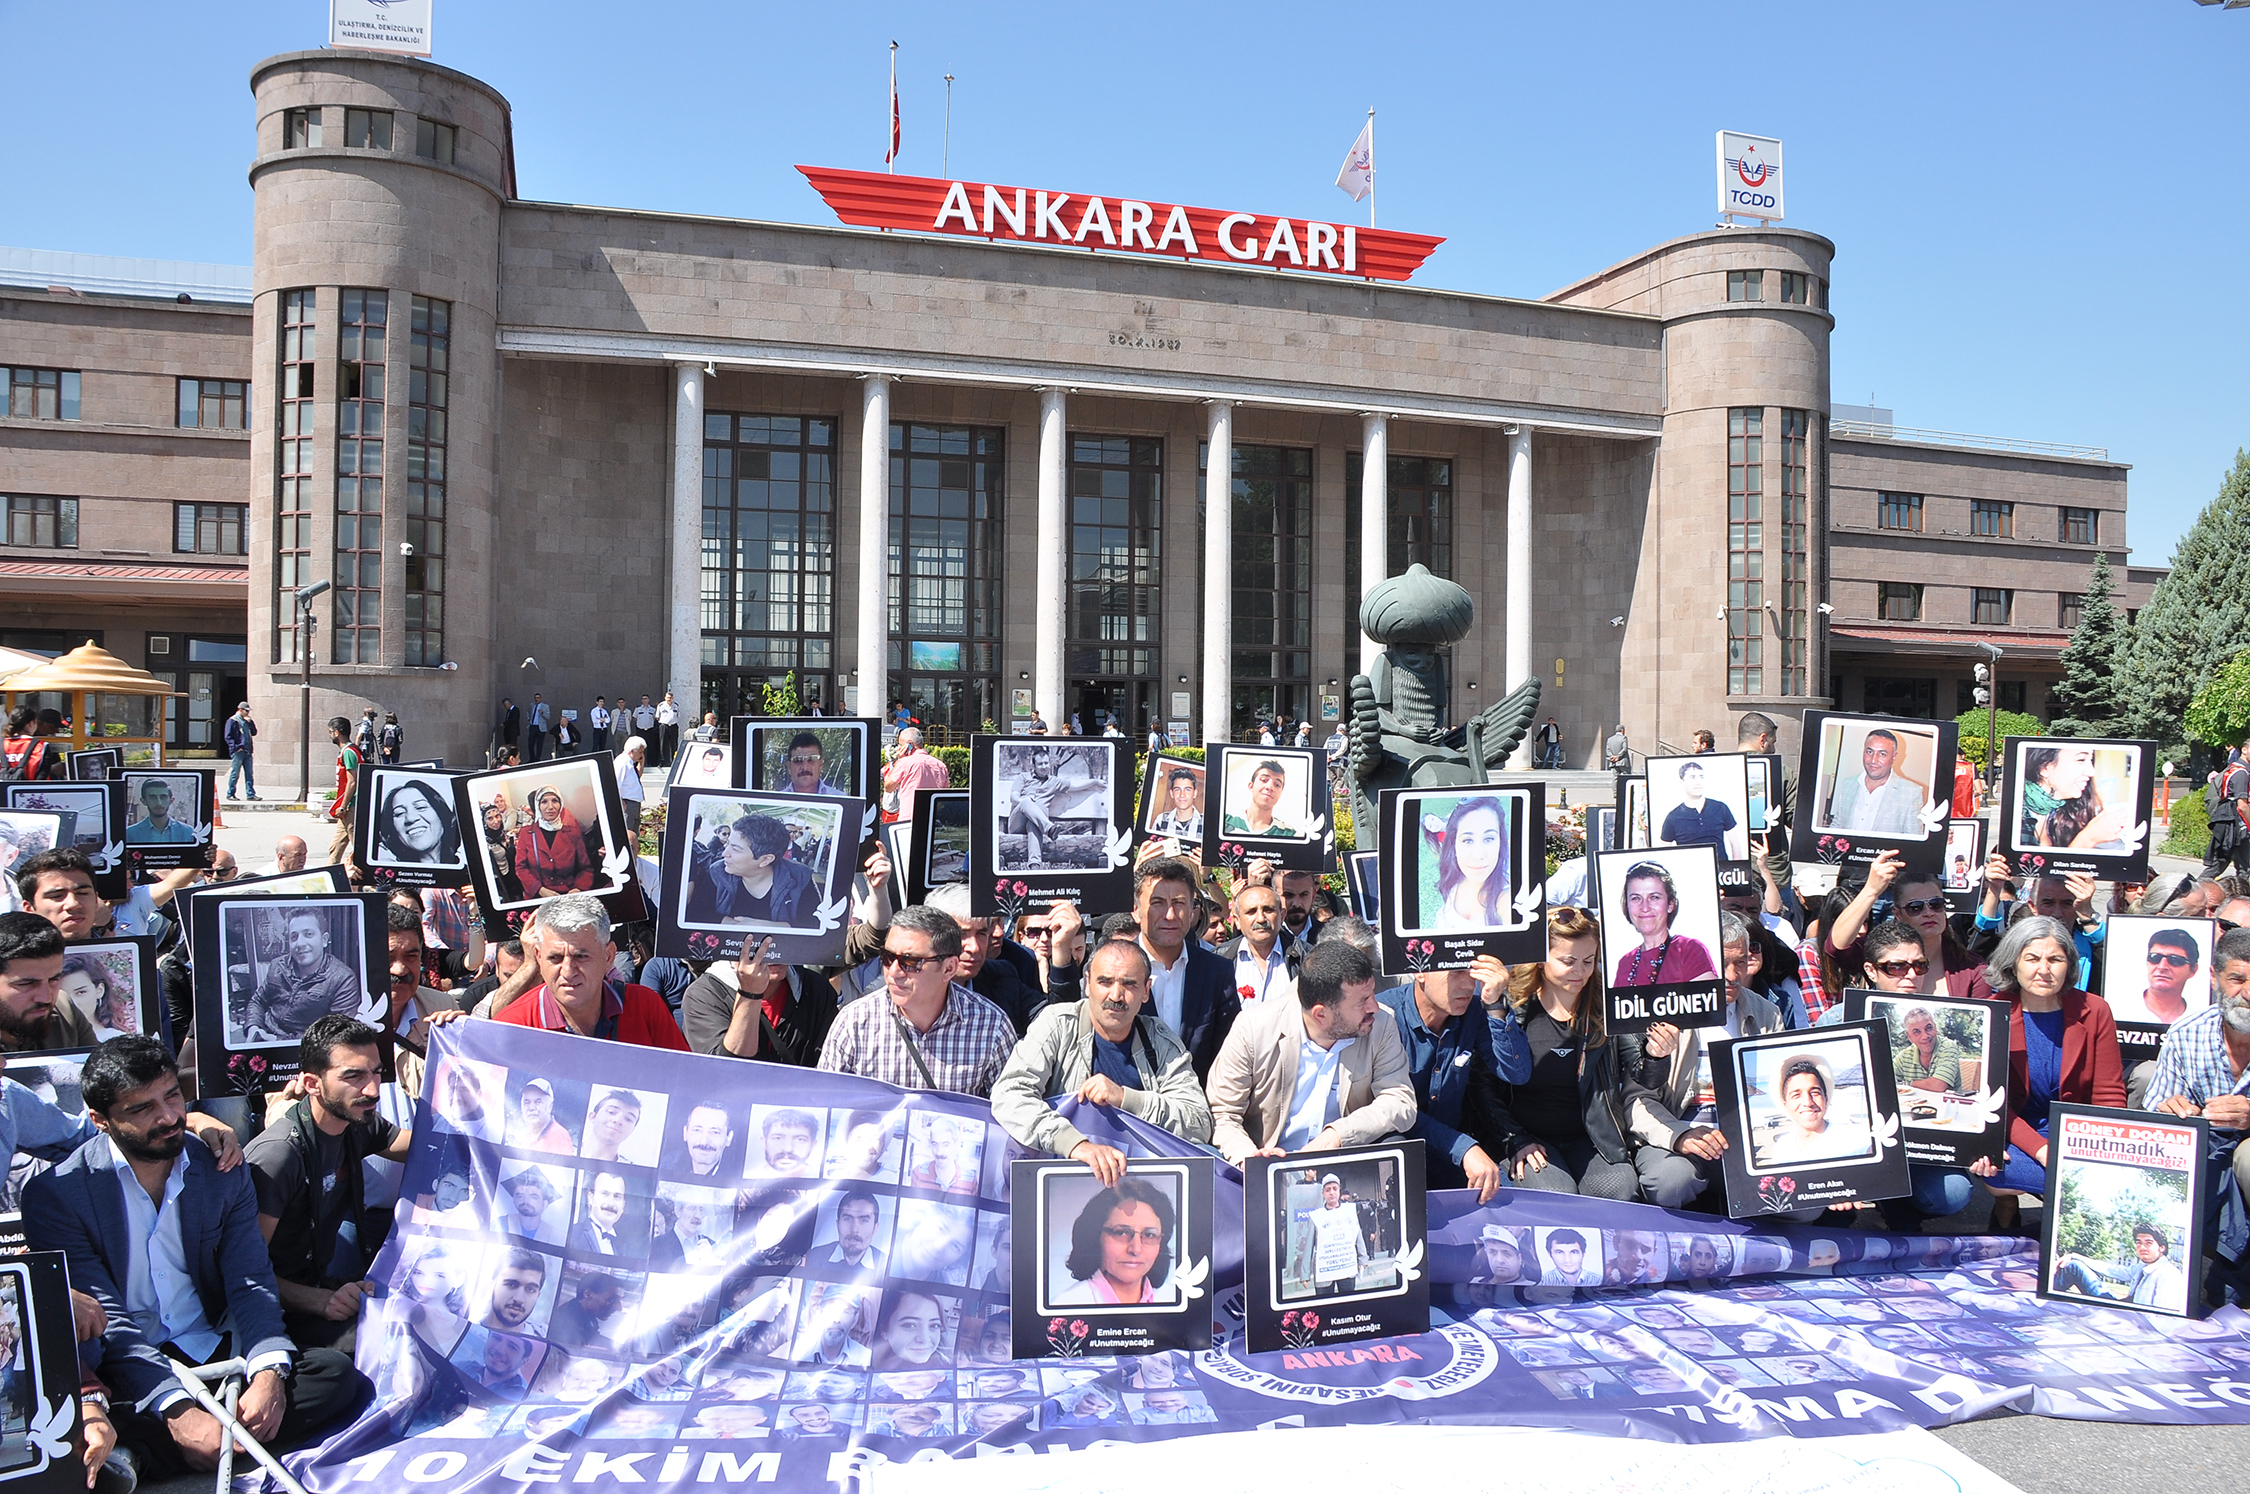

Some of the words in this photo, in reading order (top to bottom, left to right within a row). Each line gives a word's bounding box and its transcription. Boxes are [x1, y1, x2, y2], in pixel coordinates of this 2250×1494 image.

[338, 20, 377, 30] ULAŞTIRMA,
[378, 23, 414, 33] DENİZCİLİK
[342, 31, 384, 40] HABERLEŞME
[386, 34, 420, 44] BAKANLIĞI
[1731, 189, 1776, 208] TCDD
[932, 182, 1200, 255] ANKARA
[1217, 213, 1357, 272] GARI
[1028, 888, 1055, 896] Mehmet
[1066, 887, 1081, 896] Kılıç
[725, 939, 743, 948] Sevg
[1444, 940, 1466, 949] Başak
[1466, 939, 1485, 947] Sidar
[1455, 949, 1475, 959] Çevik
[1614, 994, 1651, 1020] İDİL
[1652, 988, 1718, 1017] GÜNEYİ
[2115, 1030, 2159, 1046] EVZAT
[272, 1062, 300, 1071] Nevzat
[2066, 1121, 2126, 1138] GÜNEY
[2128, 1129, 2190, 1146] DOĞAN
[1807, 1182, 1826, 1191] Eren
[1797, 1188, 1858, 1201] #Unutmayacağız
[1330, 1315, 1354, 1326] Kasım
[1355, 1314, 1372, 1322] Otur
[1096, 1328, 1122, 1337] Emine
[1123, 1327, 1147, 1336] Ercan
[1322, 1323, 1382, 1338] #Unutmayacağız
[1089, 1338, 1155, 1348] #Unutmayacağız
[1283, 1345, 1424, 1370] ANKARA
[345, 1450, 468, 1483] 10
[500, 1443, 782, 1484] EKİM
